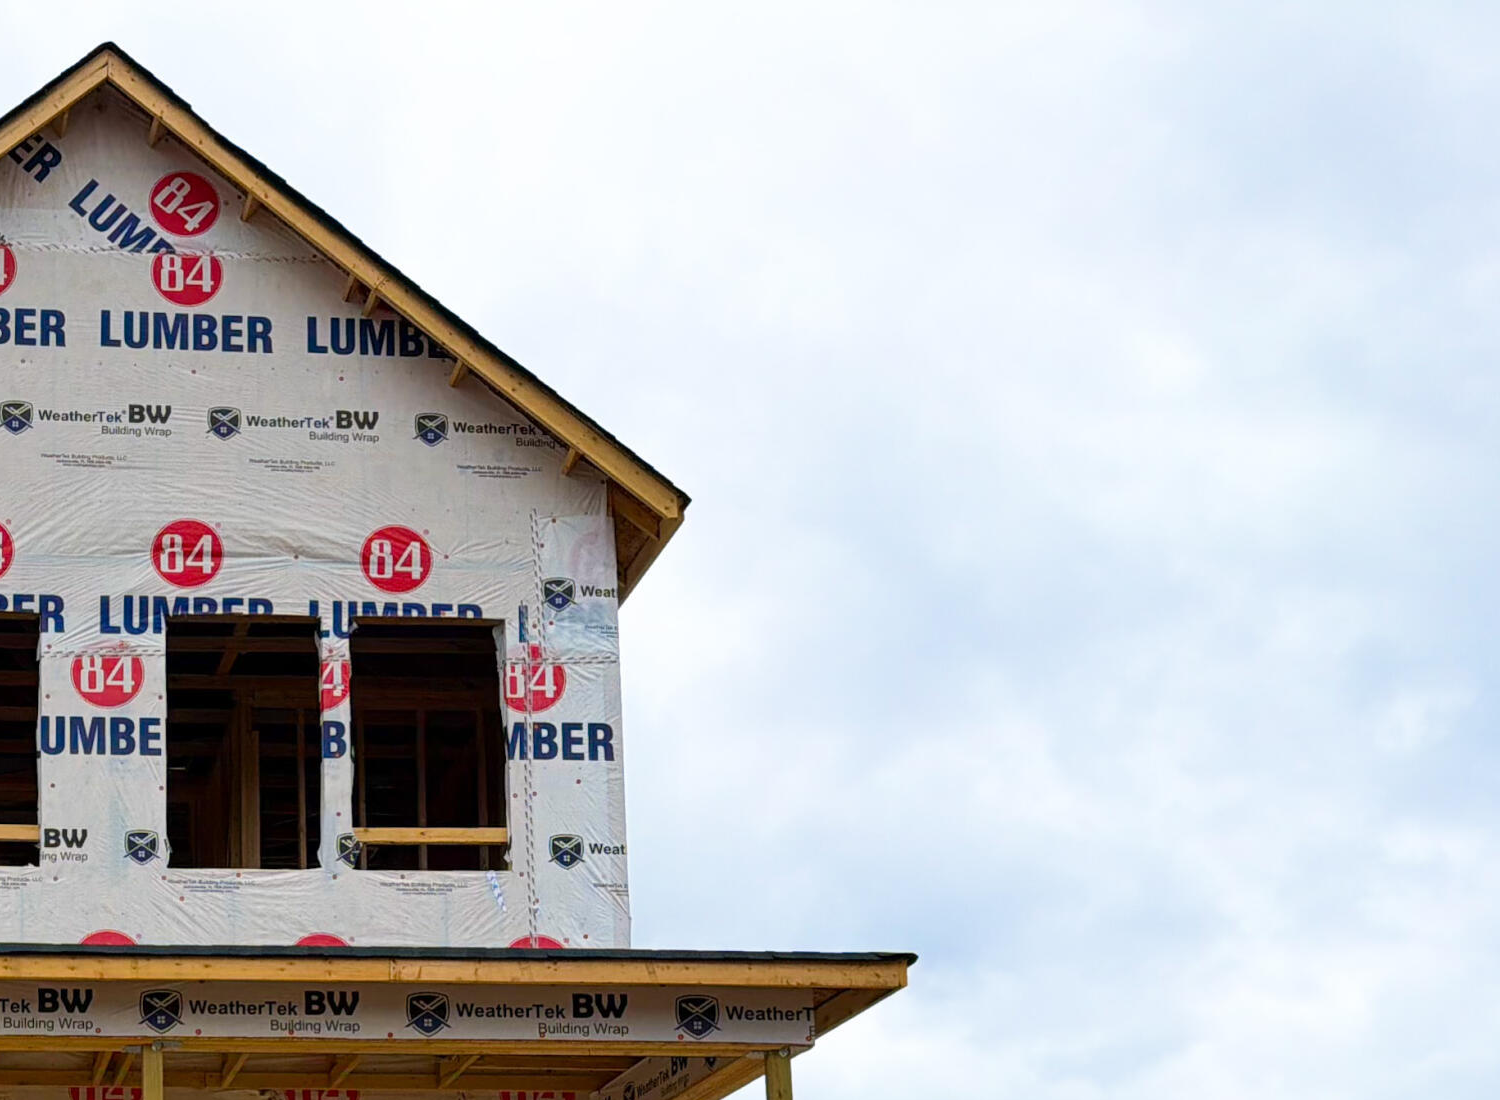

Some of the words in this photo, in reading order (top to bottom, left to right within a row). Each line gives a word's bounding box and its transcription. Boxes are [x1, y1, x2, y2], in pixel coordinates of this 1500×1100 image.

[153, 177, 214, 232] 84
[161, 254, 214, 292] 84
[100, 309, 274, 354] LUMBER
[38, 408, 122, 423] WeatherTek
[129, 404, 171, 424] BW
[246, 414, 331, 429] WeatherTek
[336, 410, 379, 430] BW
[101, 425, 143, 437] Building
[146, 426, 172, 437] Wrap
[309, 431, 350, 443] Building
[353, 432, 380, 443] Wrap
[453, 421, 536, 436] WeatherTek
[160, 534, 214, 574] 84
[369, 539, 423, 580] 84
[80, 656, 135, 693] 84
[44, 829, 88, 849] BW
[60, 851, 88, 864] Wrap
[38, 988, 93, 1013] BW
[189, 1000, 297, 1016] WeatherTek
[304, 990, 359, 1016] BW
[457, 1003, 566, 1019] WeatherTek
[572, 993, 627, 1019] BW
[3, 1016, 54, 1032] Building
[58, 1017, 93, 1032] Wrap
[270, 1019, 321, 1034] Building
[325, 1020, 360, 1034] Wrap
[538, 1023, 589, 1037] Building
[593, 1023, 629, 1037] Wrap
